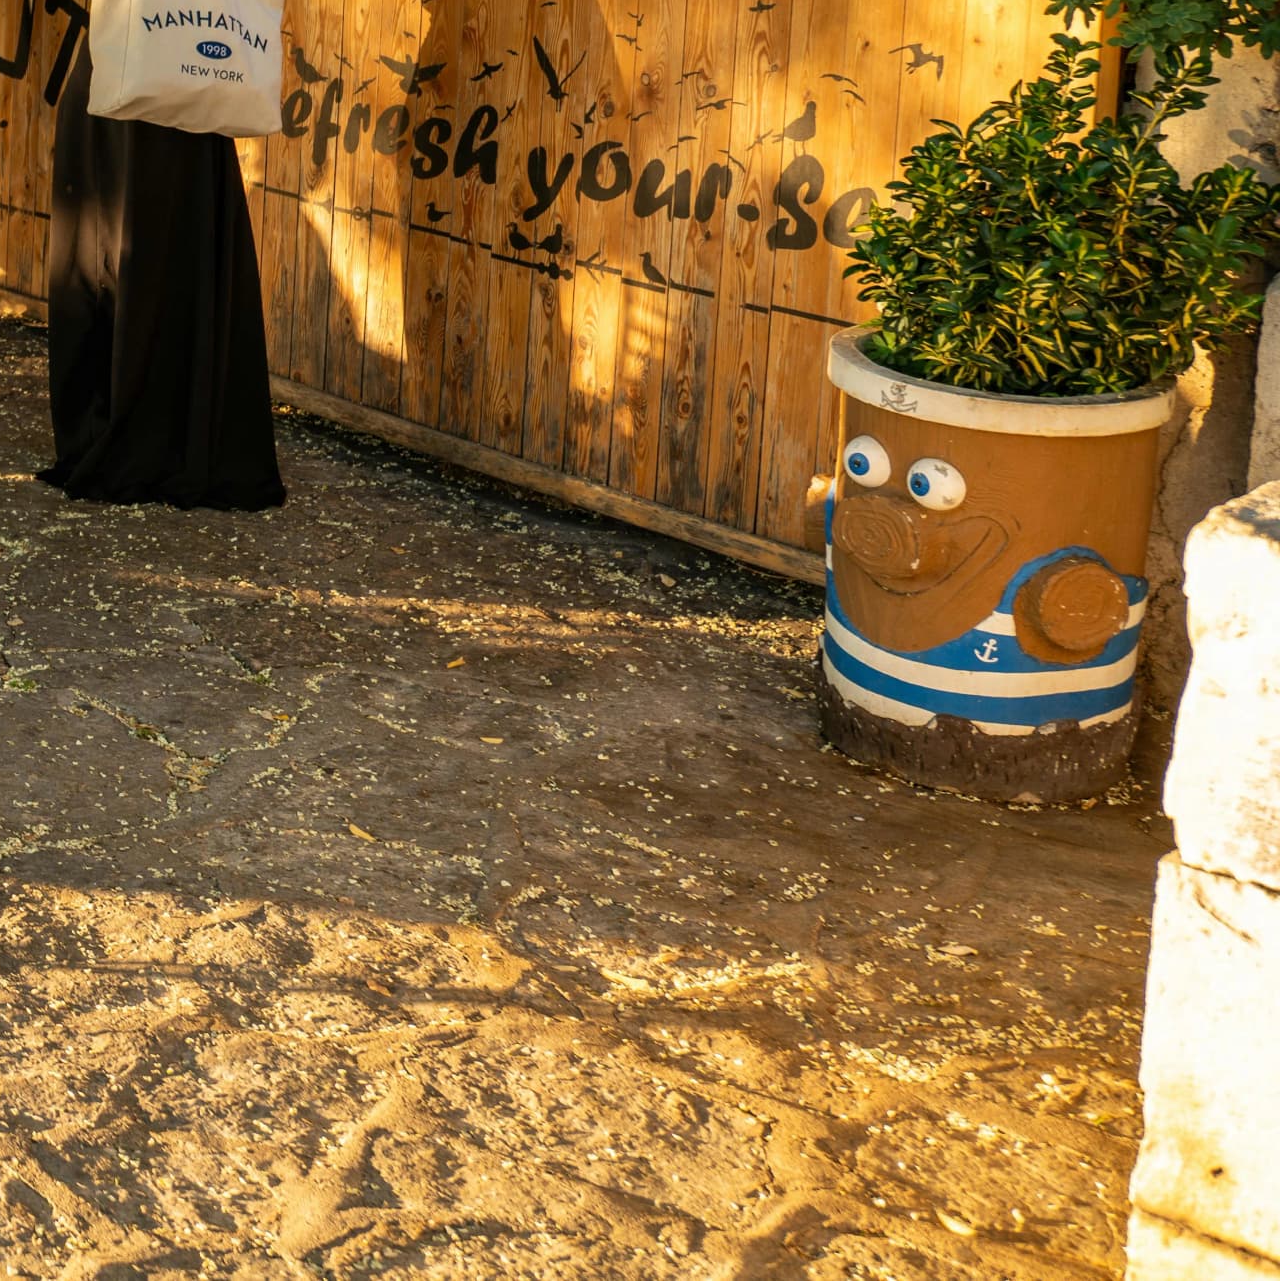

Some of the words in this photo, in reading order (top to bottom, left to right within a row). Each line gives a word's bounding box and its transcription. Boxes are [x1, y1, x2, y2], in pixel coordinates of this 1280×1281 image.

[142, 10, 268, 53] MANHATTAN
[201, 43, 227, 57] 1998
[181, 64, 210, 77] NEW
[212, 69, 244, 83] YORK
[281, 78, 500, 186] efresh
